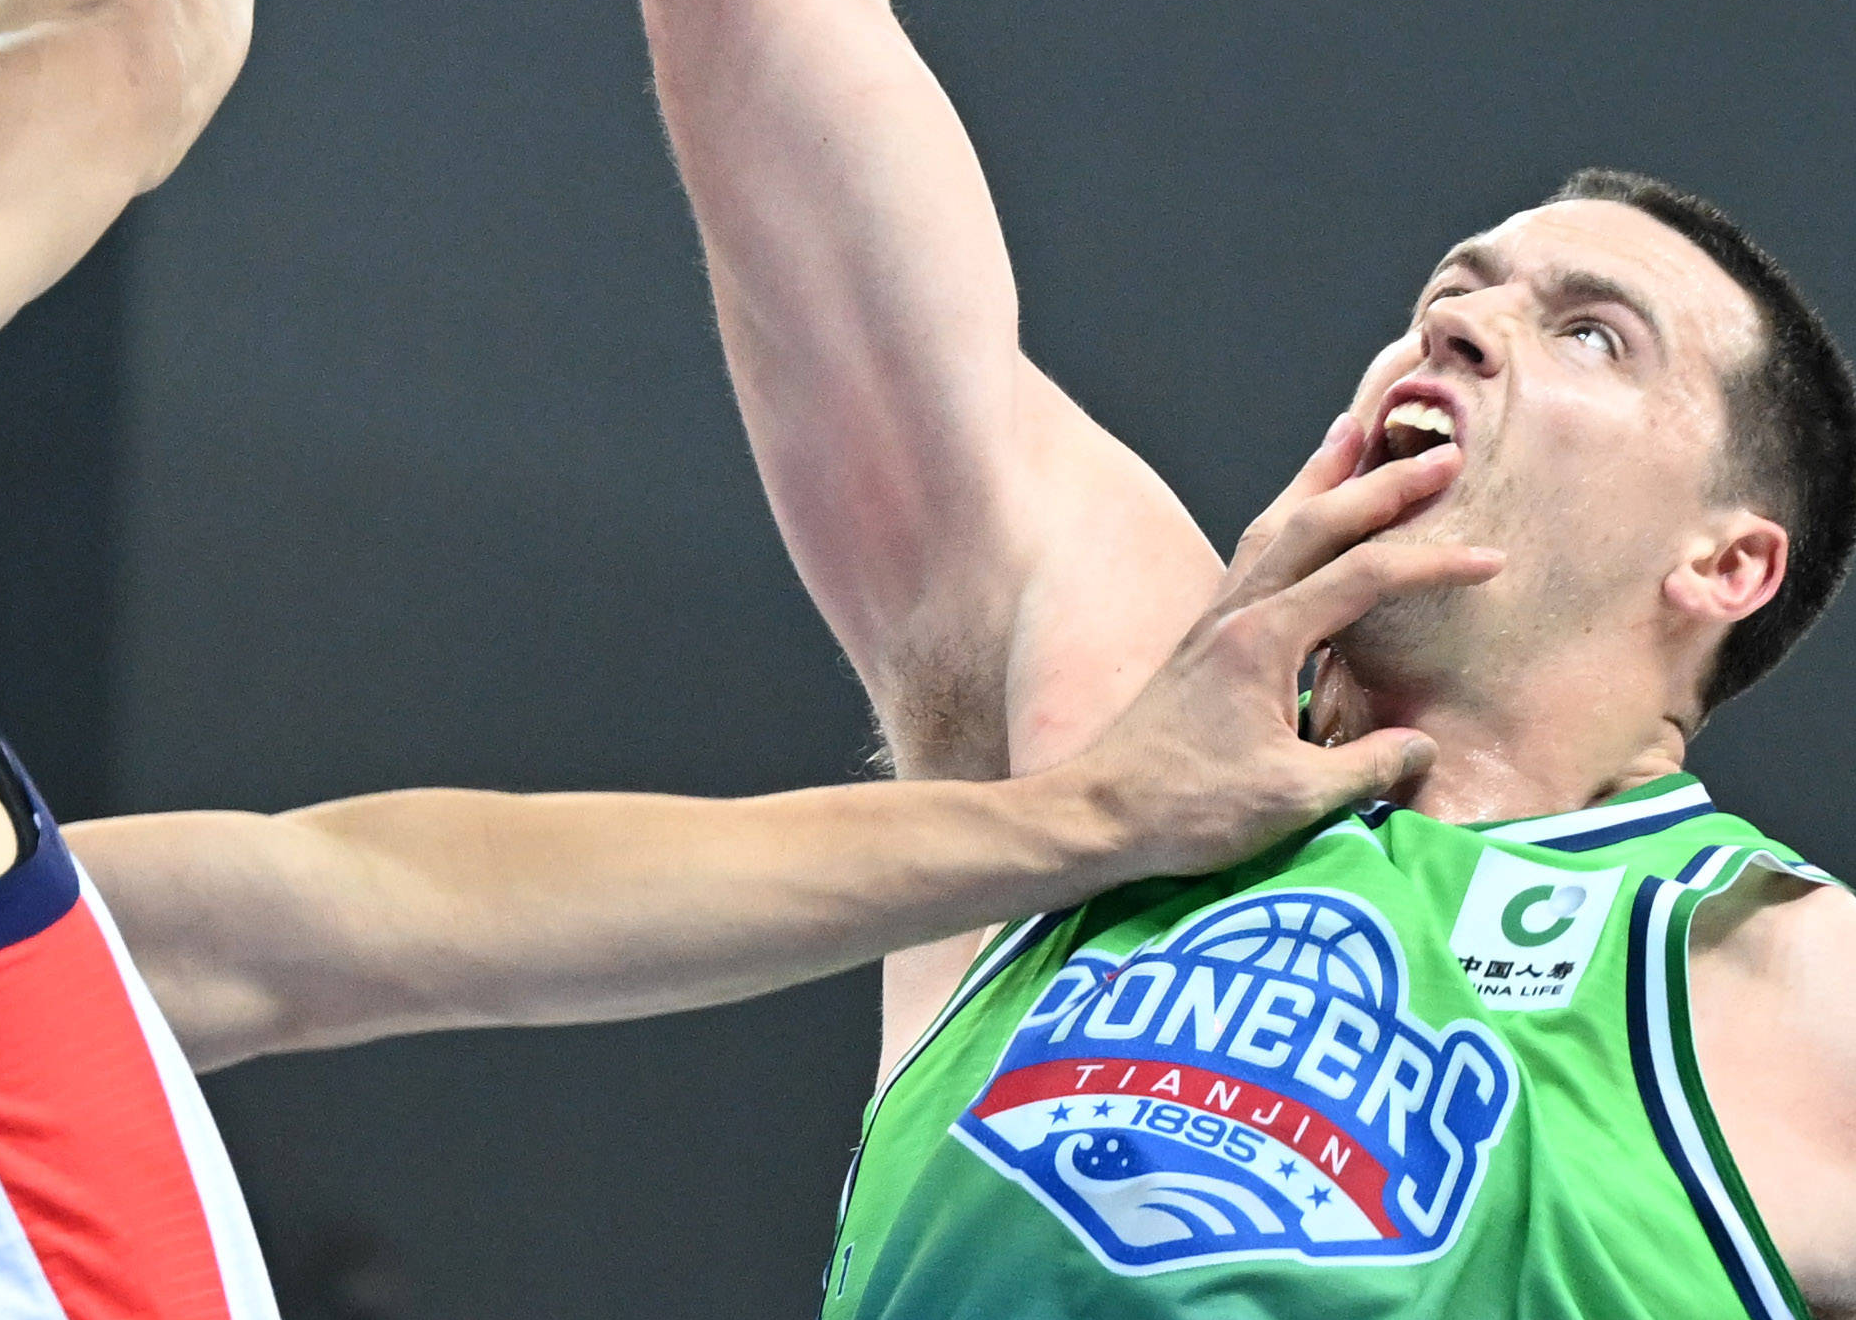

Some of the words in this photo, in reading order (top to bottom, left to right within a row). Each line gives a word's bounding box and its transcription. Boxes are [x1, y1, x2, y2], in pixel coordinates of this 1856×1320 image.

[1458, 955, 1576, 980] 中国人寿
[1520, 984, 1564, 997] LIFE
[1019, 960, 1496, 1238] PIONEERS
[1074, 1064, 1352, 1177] TIANJIN
[1127, 1098, 1267, 1163] 1895
